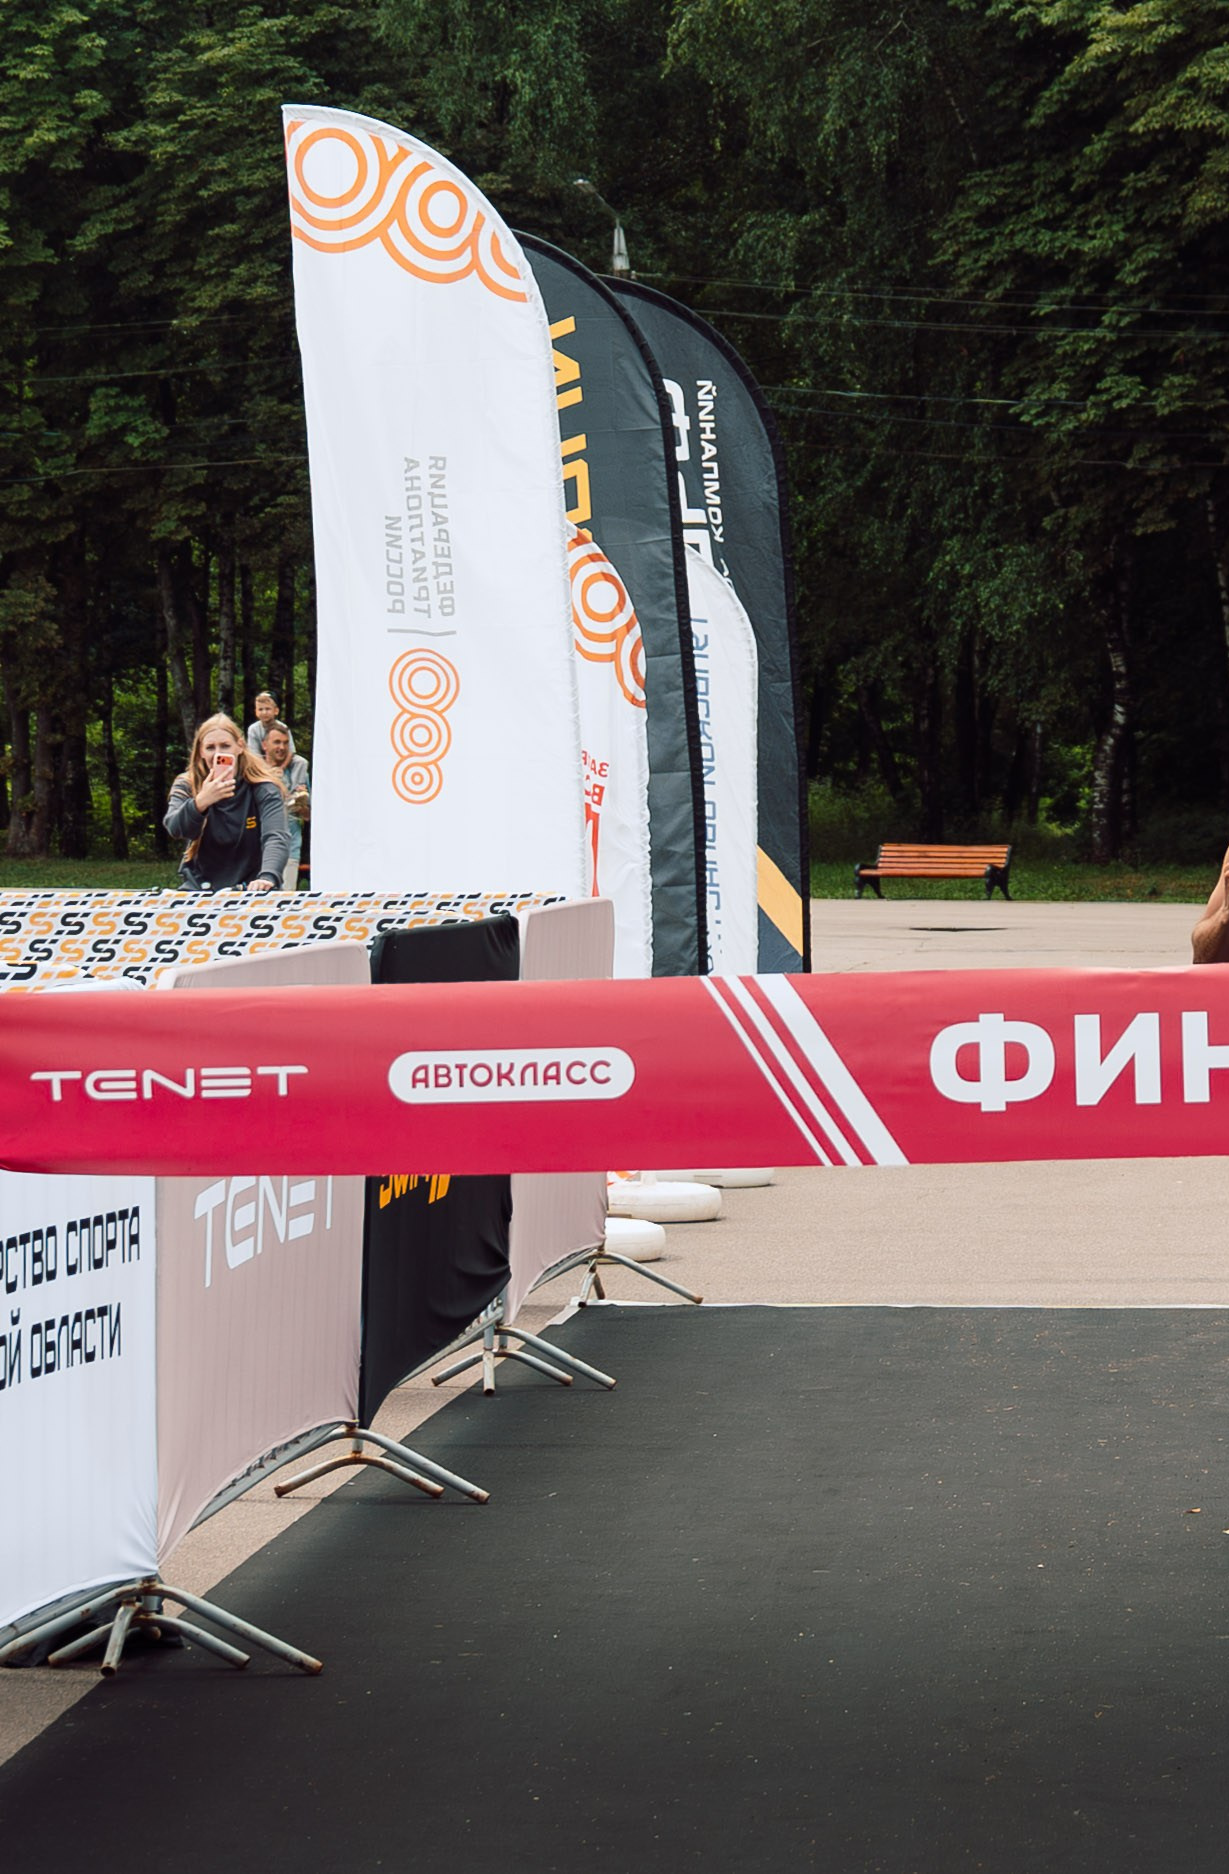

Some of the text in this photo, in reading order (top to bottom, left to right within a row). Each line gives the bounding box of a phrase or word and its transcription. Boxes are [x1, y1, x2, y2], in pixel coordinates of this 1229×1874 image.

[30, 1065, 308, 1102] TENET
[410, 1059, 613, 1091] АВТОКЛАСС
[66, 1205, 140, 1277] СПОРТА
[31, 1302, 121, 1379] ОБЛАСТИ
